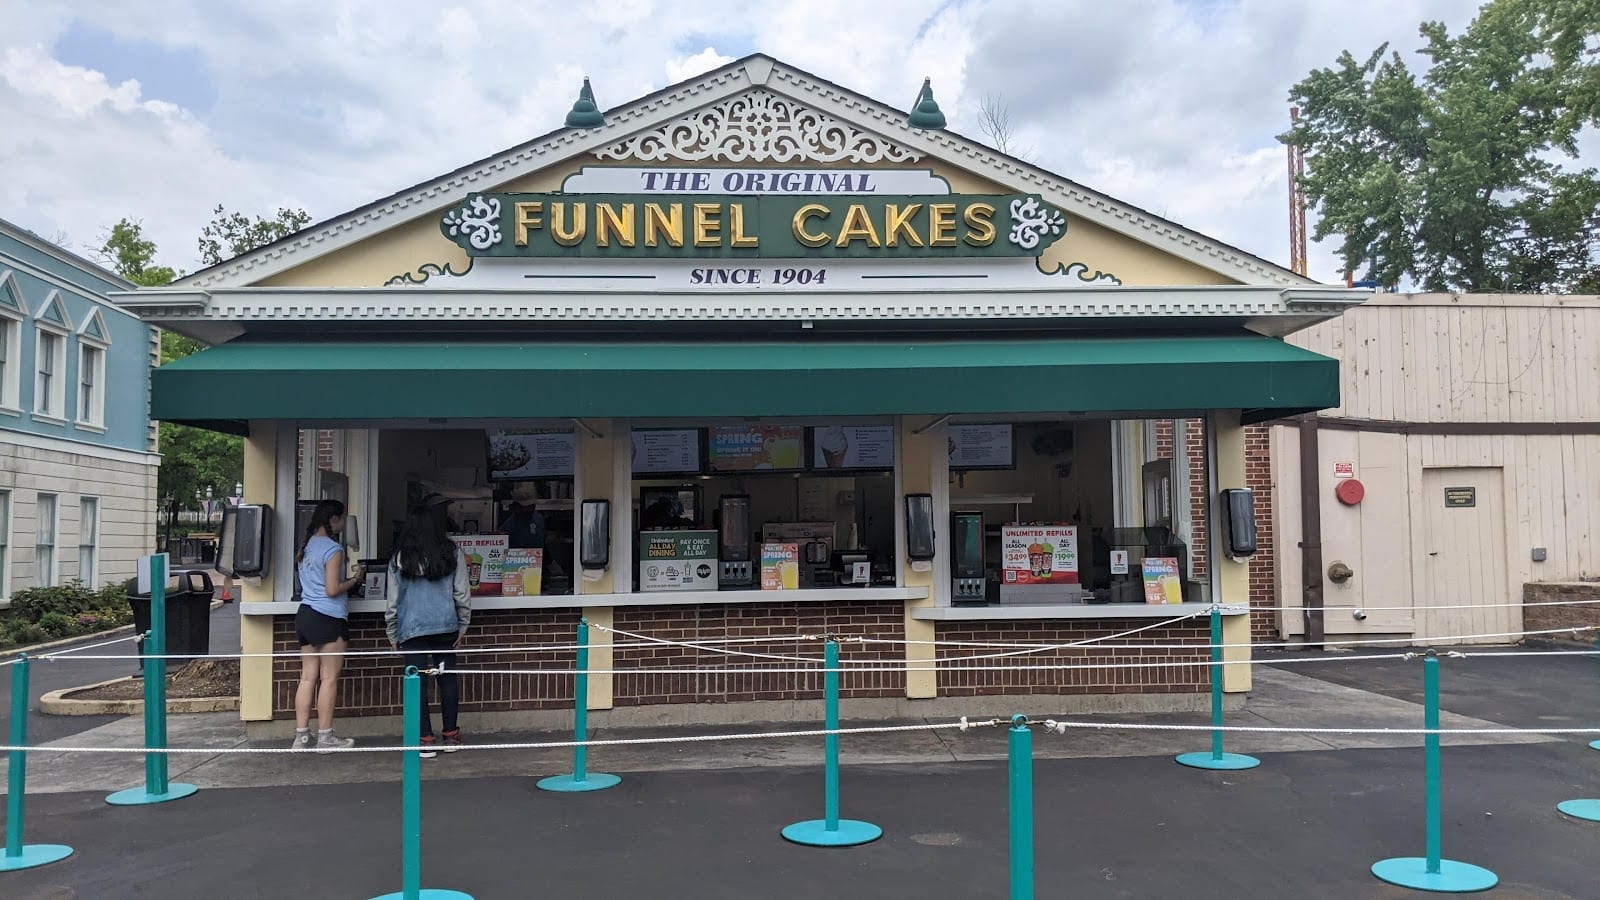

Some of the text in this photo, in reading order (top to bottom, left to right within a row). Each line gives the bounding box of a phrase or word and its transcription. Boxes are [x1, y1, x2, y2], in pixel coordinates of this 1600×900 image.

[641, 172, 876, 192] THE ORIGINAL
[514, 201, 997, 248] FUNNEL CAKES
[690, 269, 827, 285] SINCE 1904
[716, 433, 763, 444] SPRING
